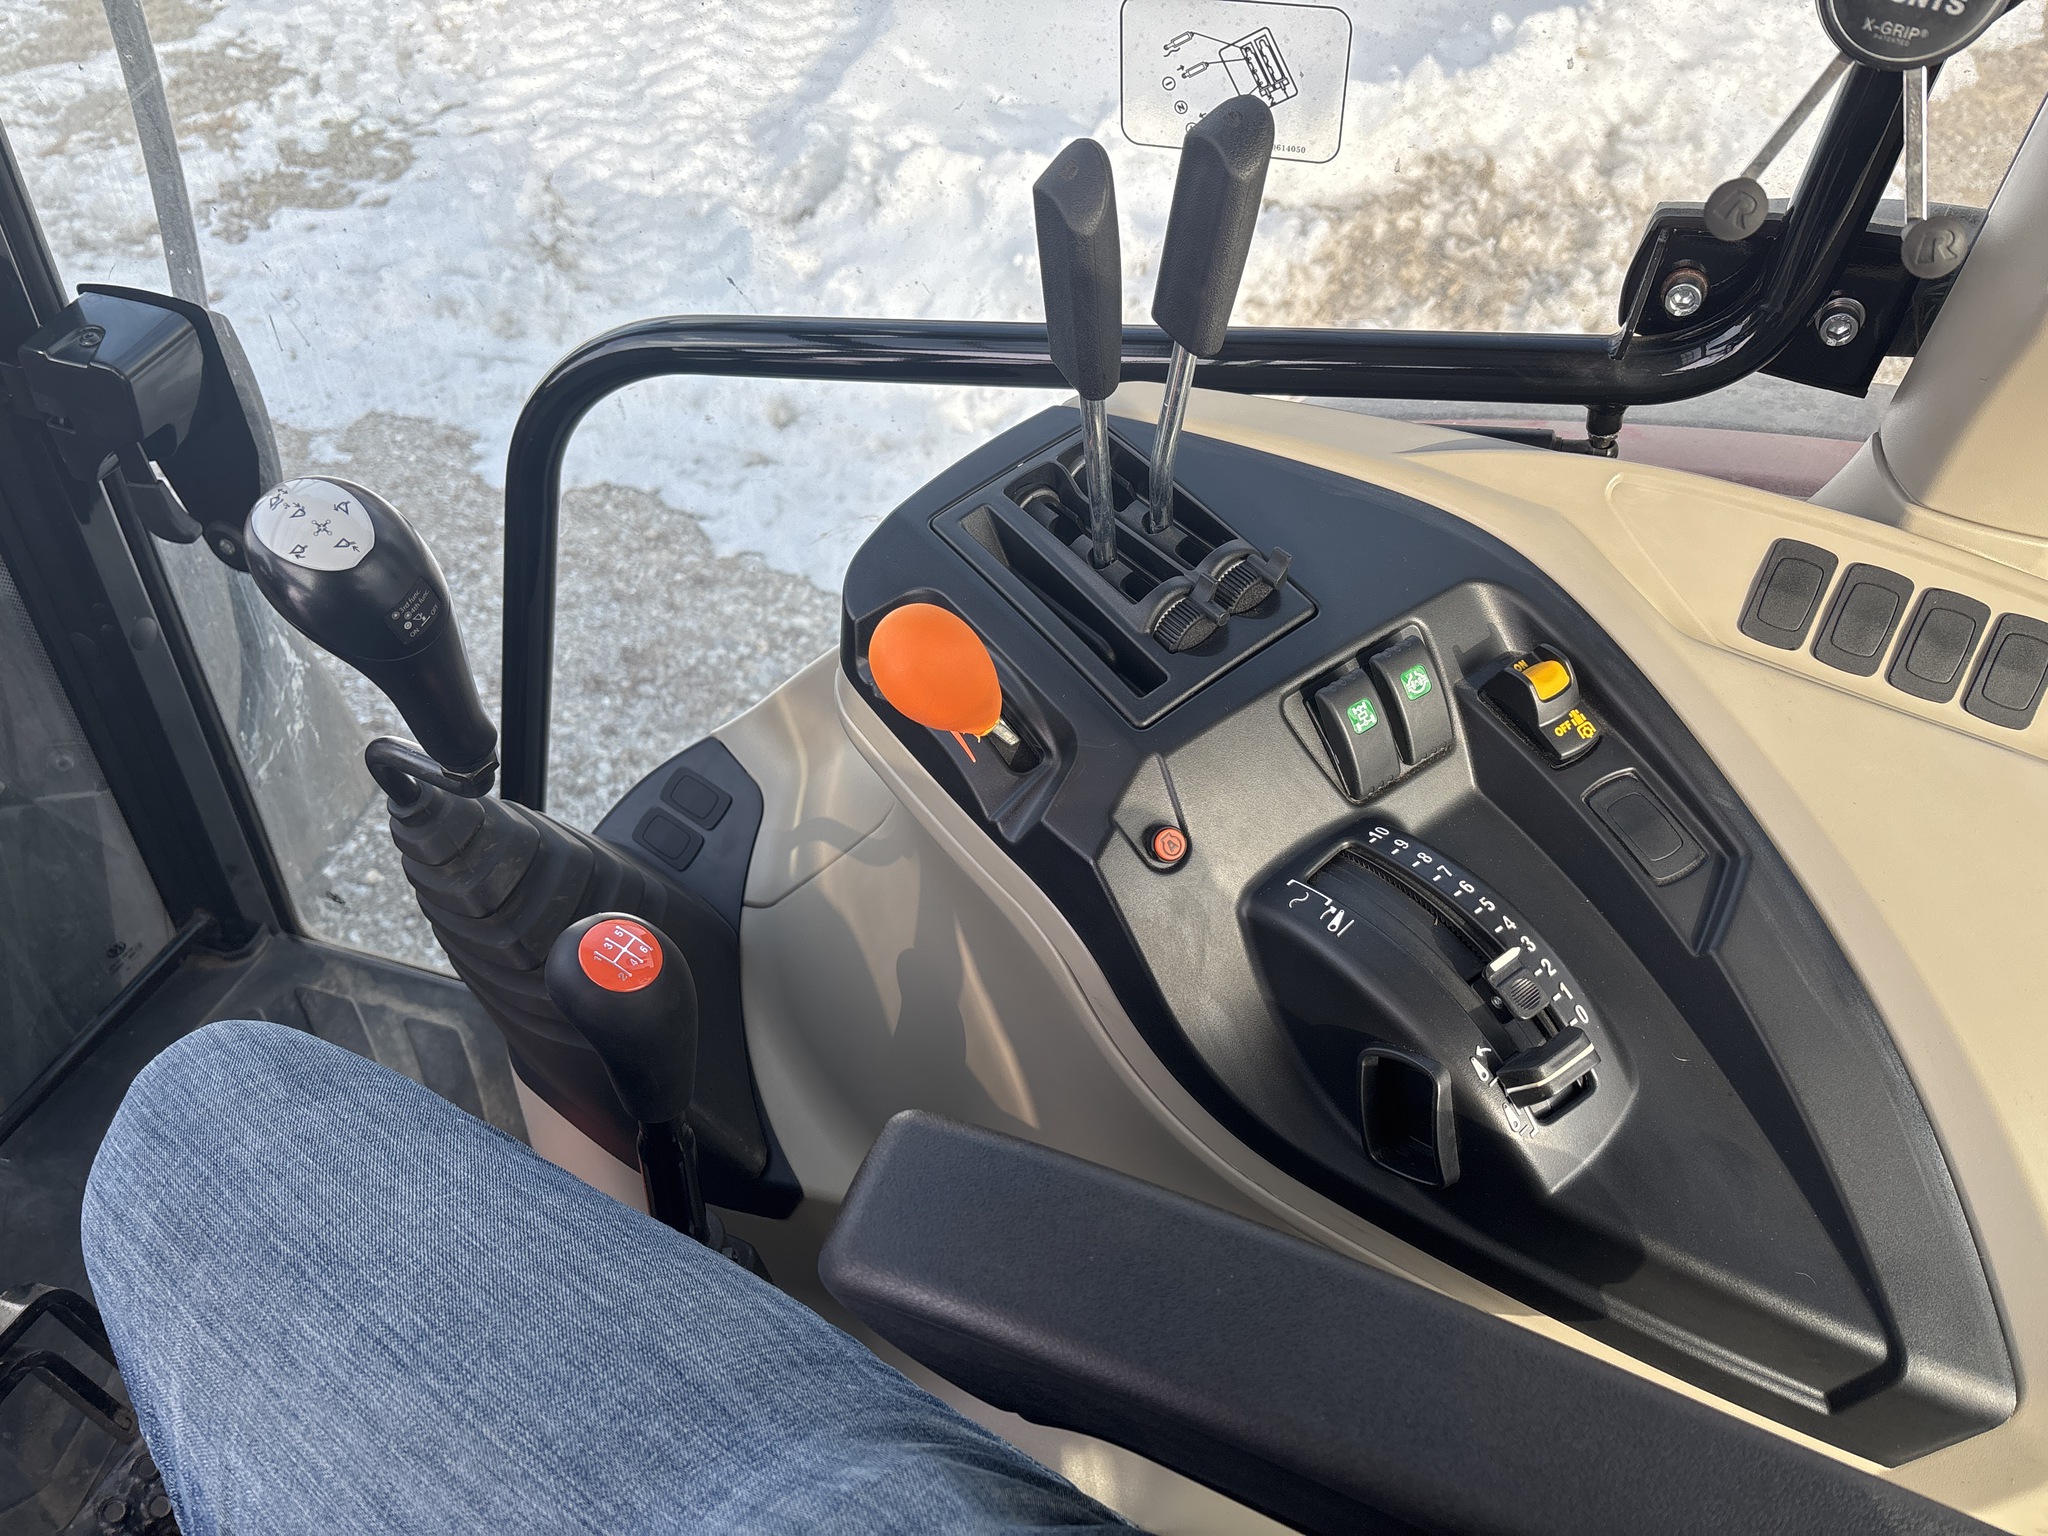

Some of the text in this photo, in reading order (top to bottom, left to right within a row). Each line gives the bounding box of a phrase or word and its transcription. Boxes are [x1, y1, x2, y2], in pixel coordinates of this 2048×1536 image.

[409, 627, 420, 638] ON
[1513, 659, 1529, 672] ON
[1554, 720, 1572, 737] OFF
[1368, 826, 1390, 840] 10
[1393, 839, 1409, 849] 9
[1416, 852, 1433, 864] 8
[1436, 864, 1453, 877] 7
[1458, 880, 1475, 894] 6
[1478, 896, 1496, 912] 5
[1502, 915, 1517, 930] 4
[613, 929, 624, 937] 5
[603, 942, 613, 950] 3
[639, 945, 649, 954] 6
[1520, 935, 1537, 952] 3
[629, 958, 639, 966] 4
[1540, 958, 1557, 977] 2
[617, 972, 628, 982] 2
[1559, 981, 1574, 1000] 1
[1575, 1004, 1589, 1024] 0
